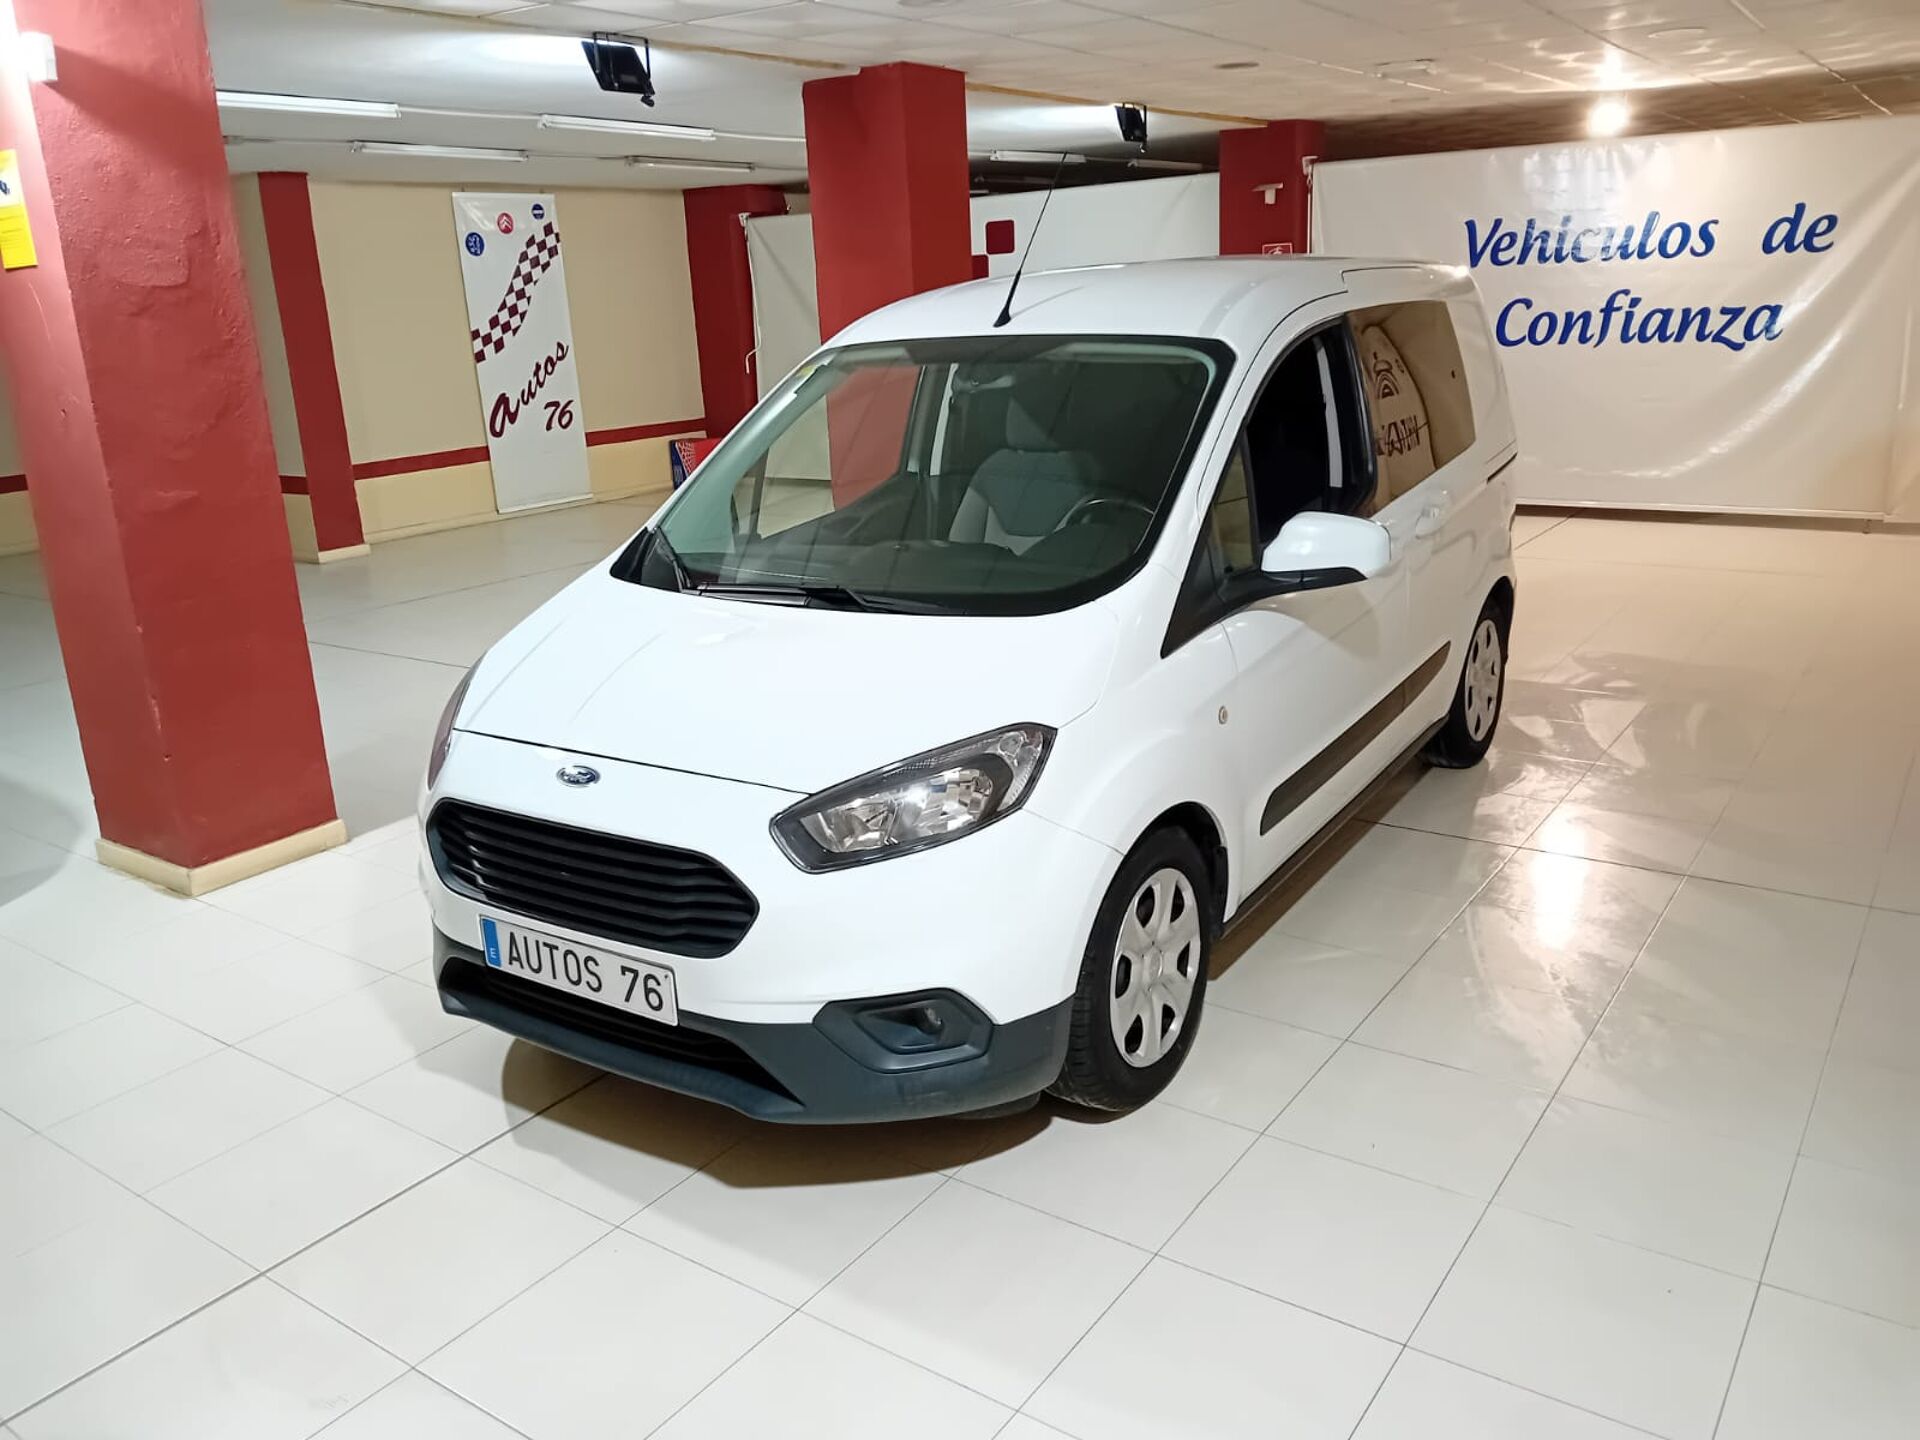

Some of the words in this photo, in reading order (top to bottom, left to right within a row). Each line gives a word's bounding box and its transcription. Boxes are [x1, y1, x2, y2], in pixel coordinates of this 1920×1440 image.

[1762, 202, 1838, 255] de
[1496, 289, 1784, 351] Confianza
[544, 400, 574, 431] 76
[508, 931, 602, 993] AUTOS
[620, 965, 663, 1012] 76
